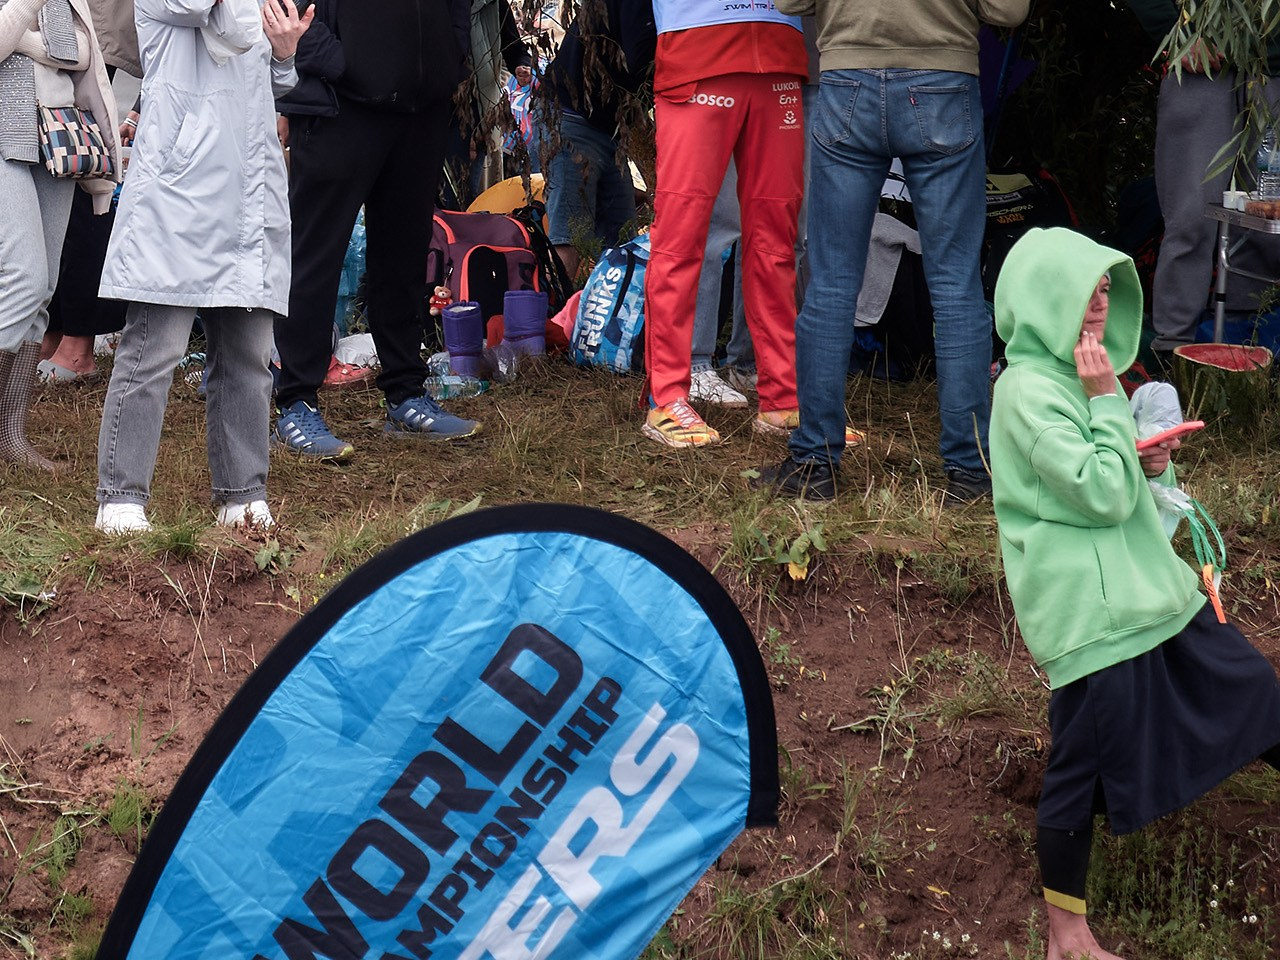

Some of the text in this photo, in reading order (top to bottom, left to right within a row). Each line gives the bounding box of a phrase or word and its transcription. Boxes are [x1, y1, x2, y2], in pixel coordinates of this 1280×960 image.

[772, 82, 801, 92] LUKOIL
[578, 270, 606, 351] FUNKY
[584, 266, 622, 359] TRUNKS
[375, 676, 622, 960] MPIONSHIP
